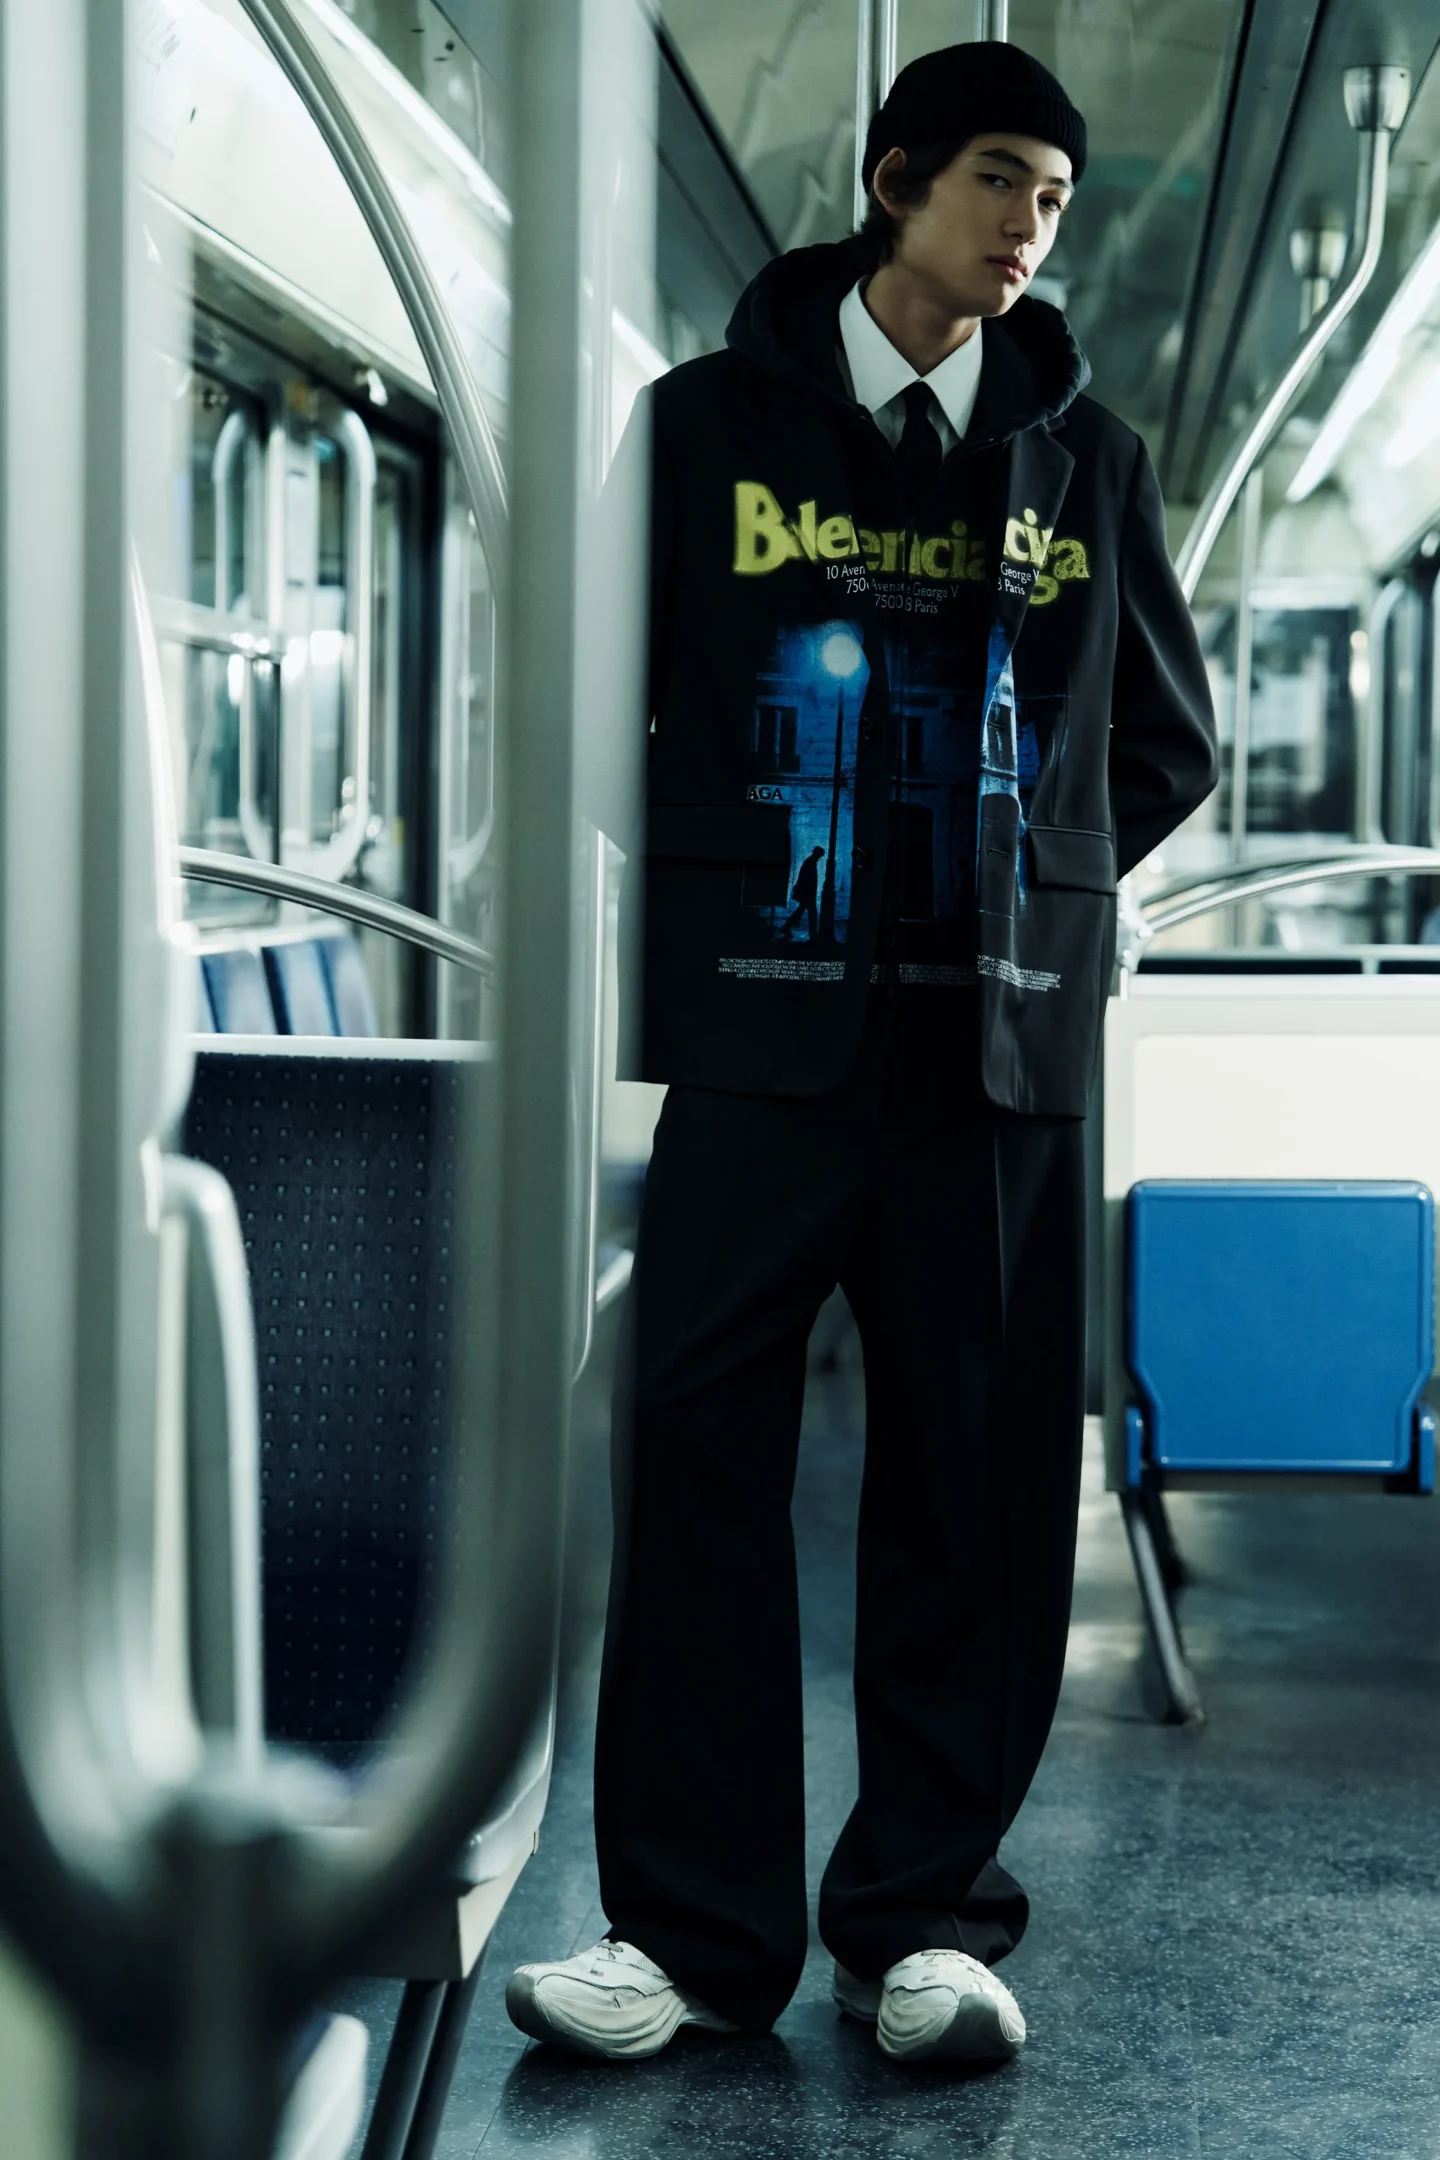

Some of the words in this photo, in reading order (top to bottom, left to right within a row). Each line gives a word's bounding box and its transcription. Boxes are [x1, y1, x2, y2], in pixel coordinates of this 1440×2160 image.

[826, 564, 839, 580] 10
[1000, 561, 1032, 584] George
[1033, 568, 1040, 582] V
[846, 576, 870, 594] 750
[912, 581, 948, 601] George
[950, 584, 960, 598] V
[1005, 578, 1026, 595] Paris
[914, 598, 939, 614] Paris
